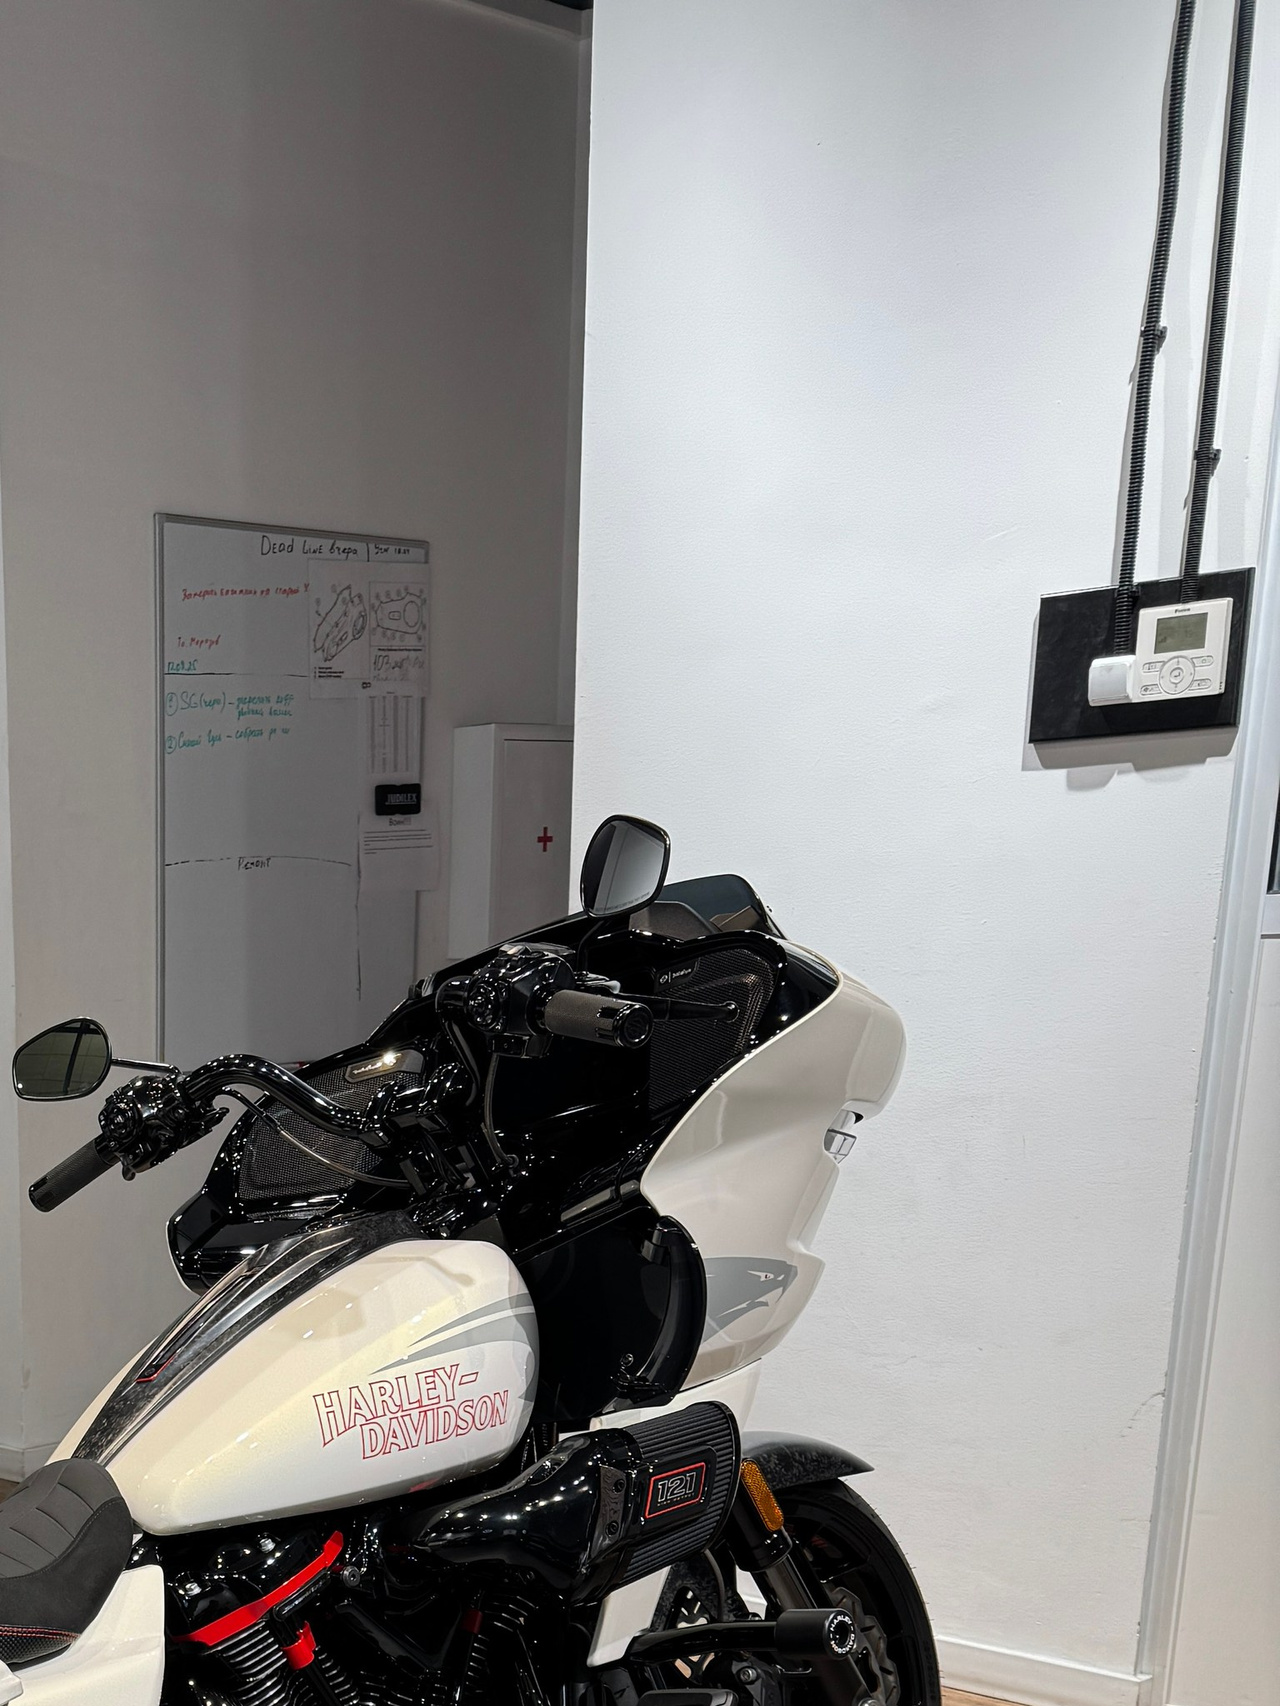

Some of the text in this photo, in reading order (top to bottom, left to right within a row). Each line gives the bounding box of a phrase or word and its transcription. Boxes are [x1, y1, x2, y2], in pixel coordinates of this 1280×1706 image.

[313, 1363, 480, 1448] HARLEY-
[359, 1390, 510, 1460] DAVIDSON
[658, 1472, 697, 1502] 121
